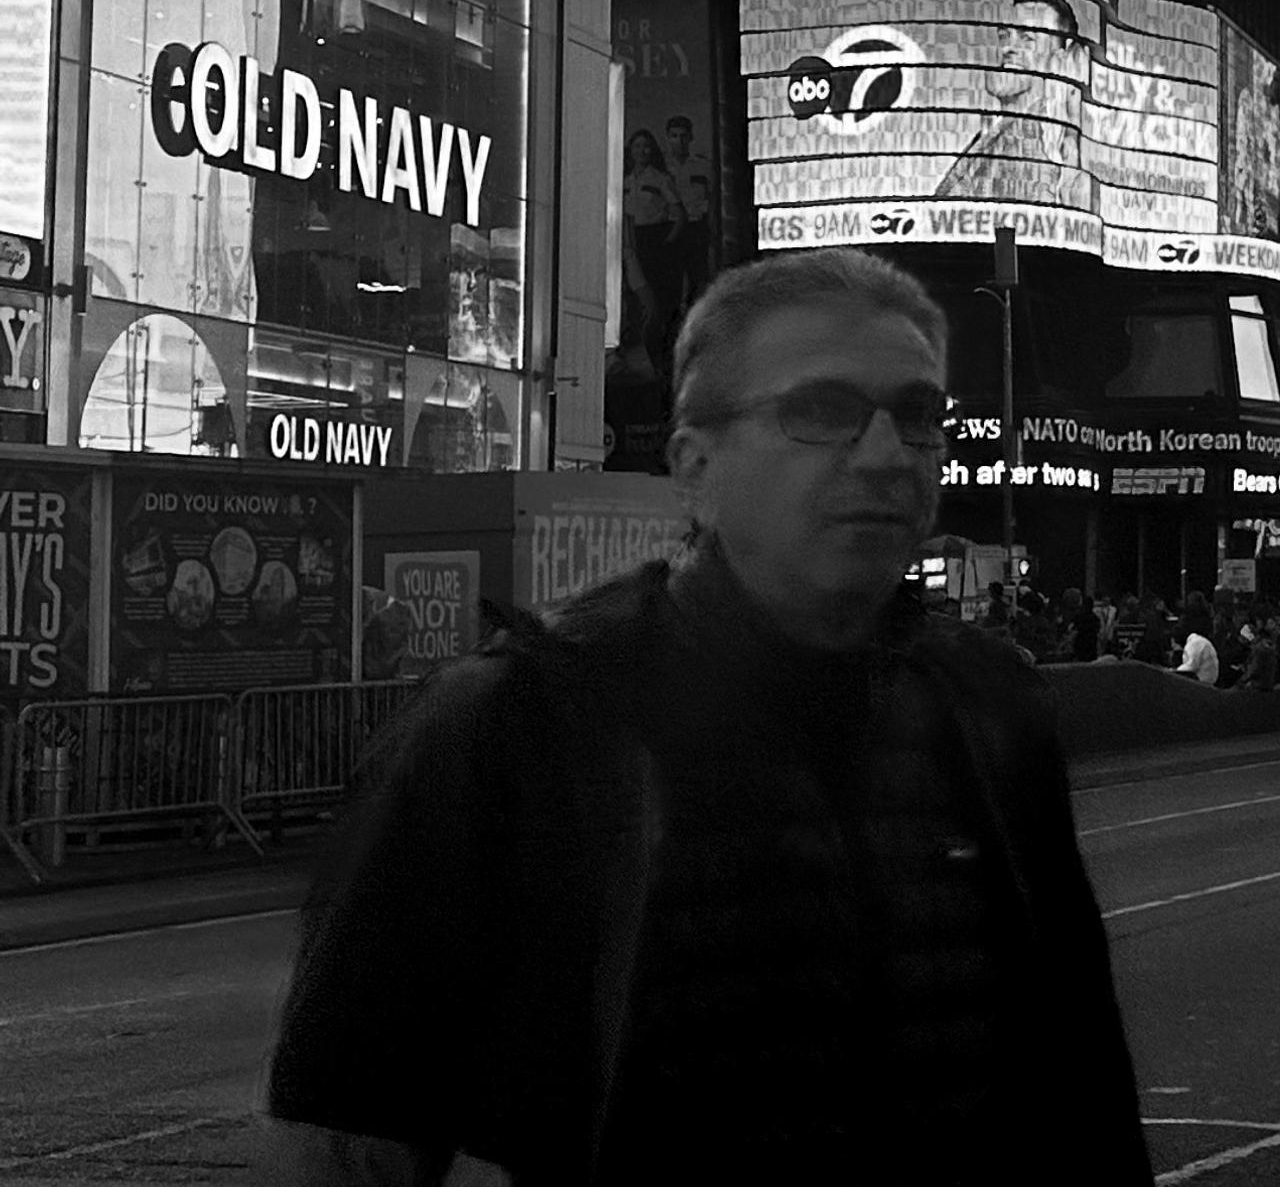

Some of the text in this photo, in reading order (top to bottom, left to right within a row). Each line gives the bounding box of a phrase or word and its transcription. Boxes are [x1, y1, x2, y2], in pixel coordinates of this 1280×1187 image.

[789, 76, 831, 103] abc
[191, 41, 492, 227] OLD NAVY
[813, 212, 860, 238] 9AM
[1111, 236, 1149, 264] 9AM
[270, 413, 393, 468] OLD NAVY
[1023, 417, 1078, 443] NATO
[1096, 429, 1153, 452] North
[1159, 429, 1242, 452] Korean
[975, 459, 1039, 486] afer
[1041, 462, 1077, 487] two
[1111, 467, 1206, 494] ESPN
[1233, 468, 1277, 494] Bears
[144, 493, 178, 512] DID
[182, 494, 219, 513] YOU
[224, 495, 279, 514] KNOW
[403, 569, 461, 598] YOU ARE
[408, 600, 460, 629] NOT
